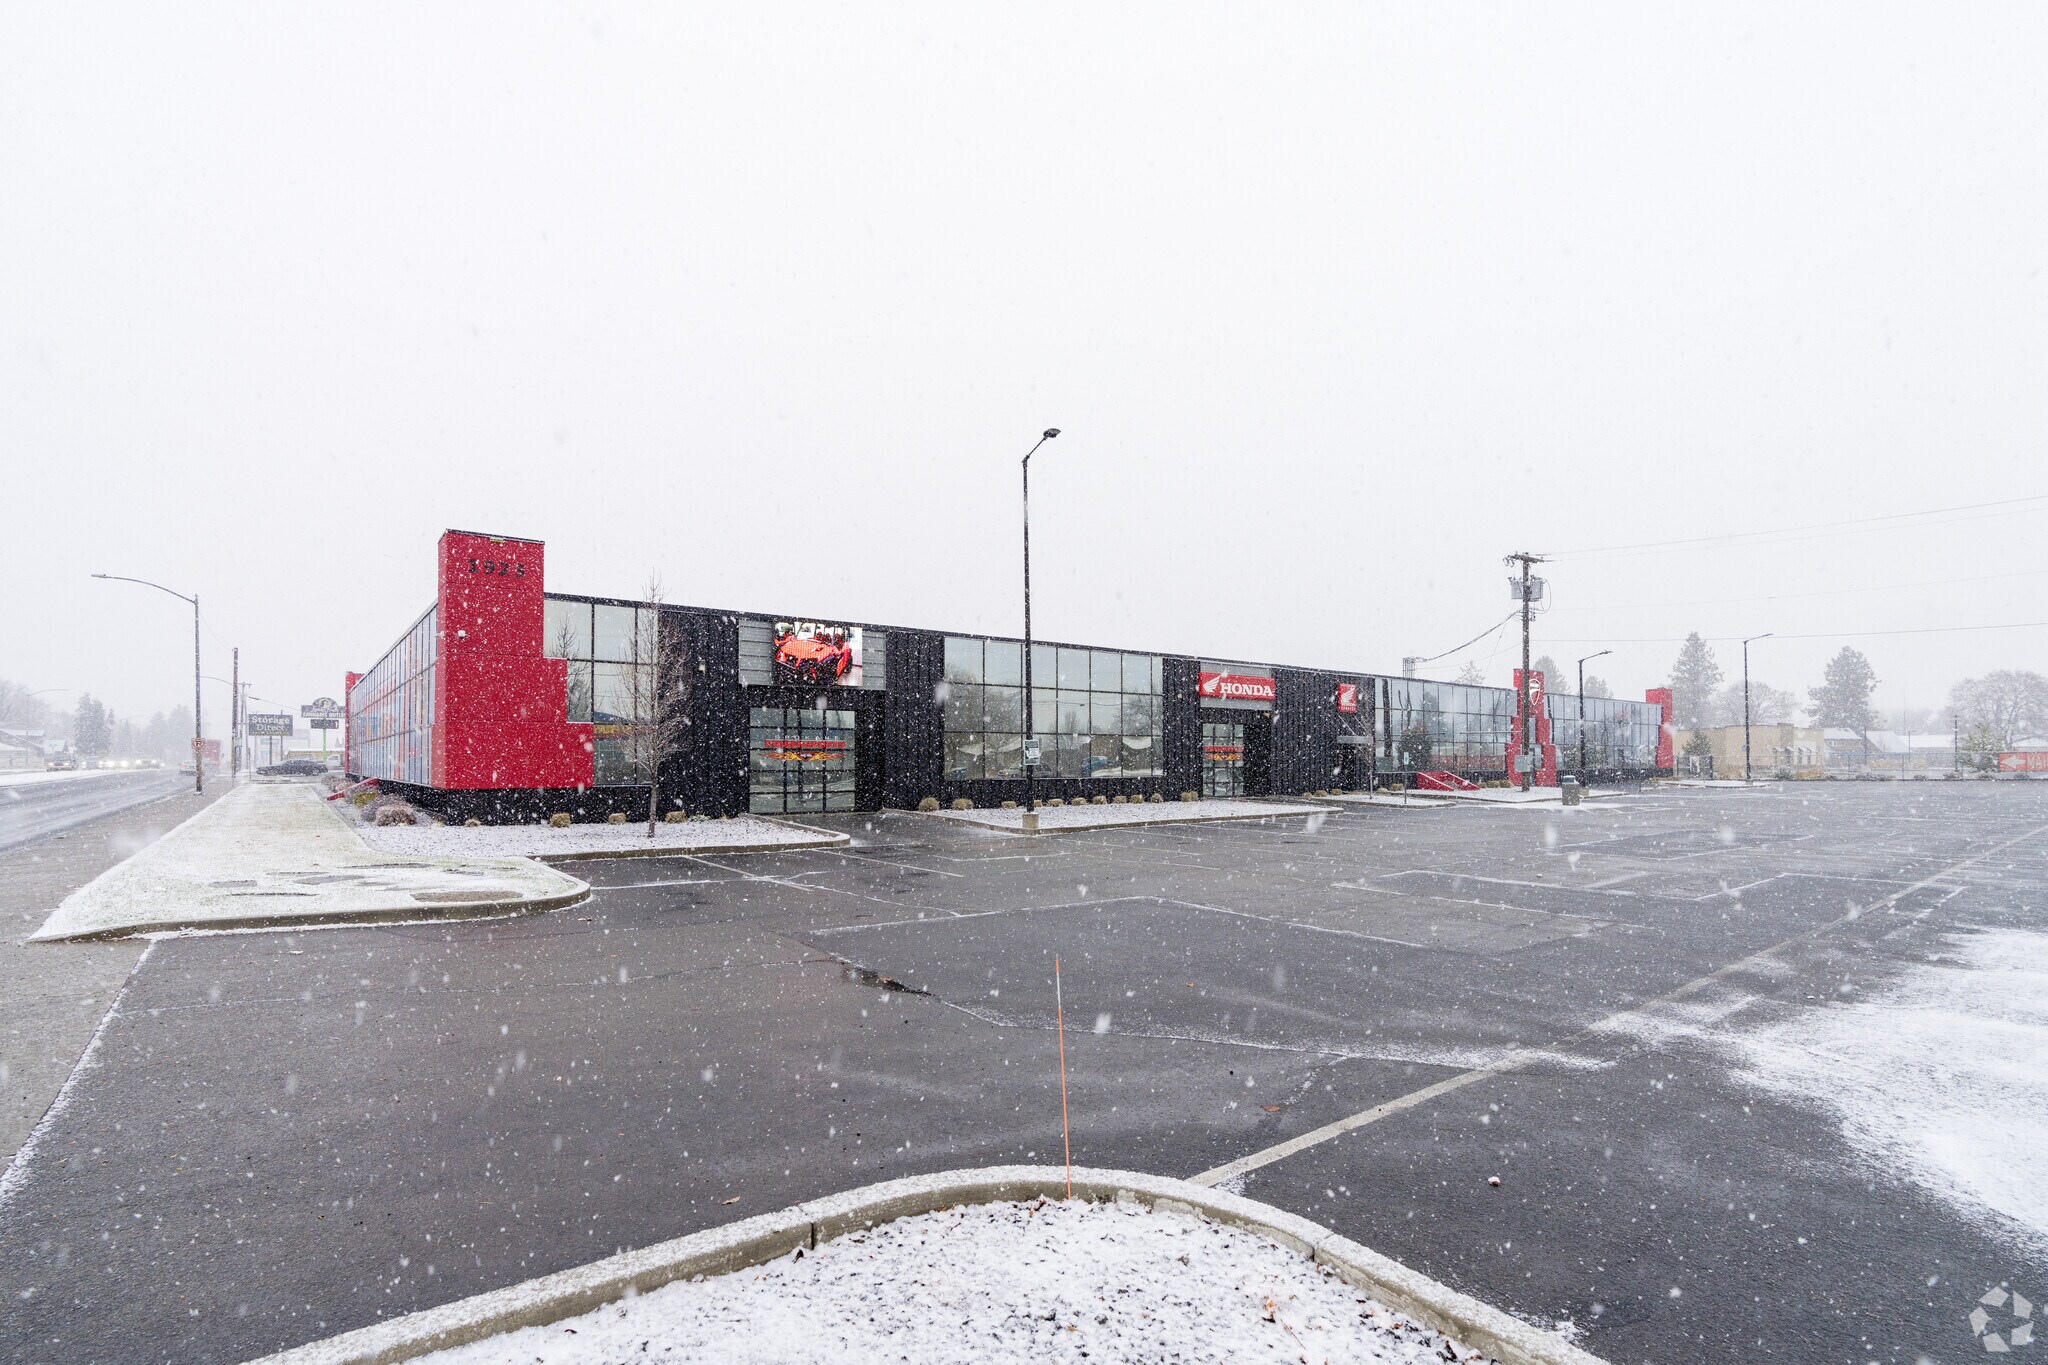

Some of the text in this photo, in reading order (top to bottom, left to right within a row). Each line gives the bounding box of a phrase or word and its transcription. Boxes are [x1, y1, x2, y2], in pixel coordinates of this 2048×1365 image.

[468, 559, 526, 578] 1925
[1220, 682, 1275, 697] HONDA
[251, 715, 290, 727] Storage
[256, 723, 286, 732] Direct
